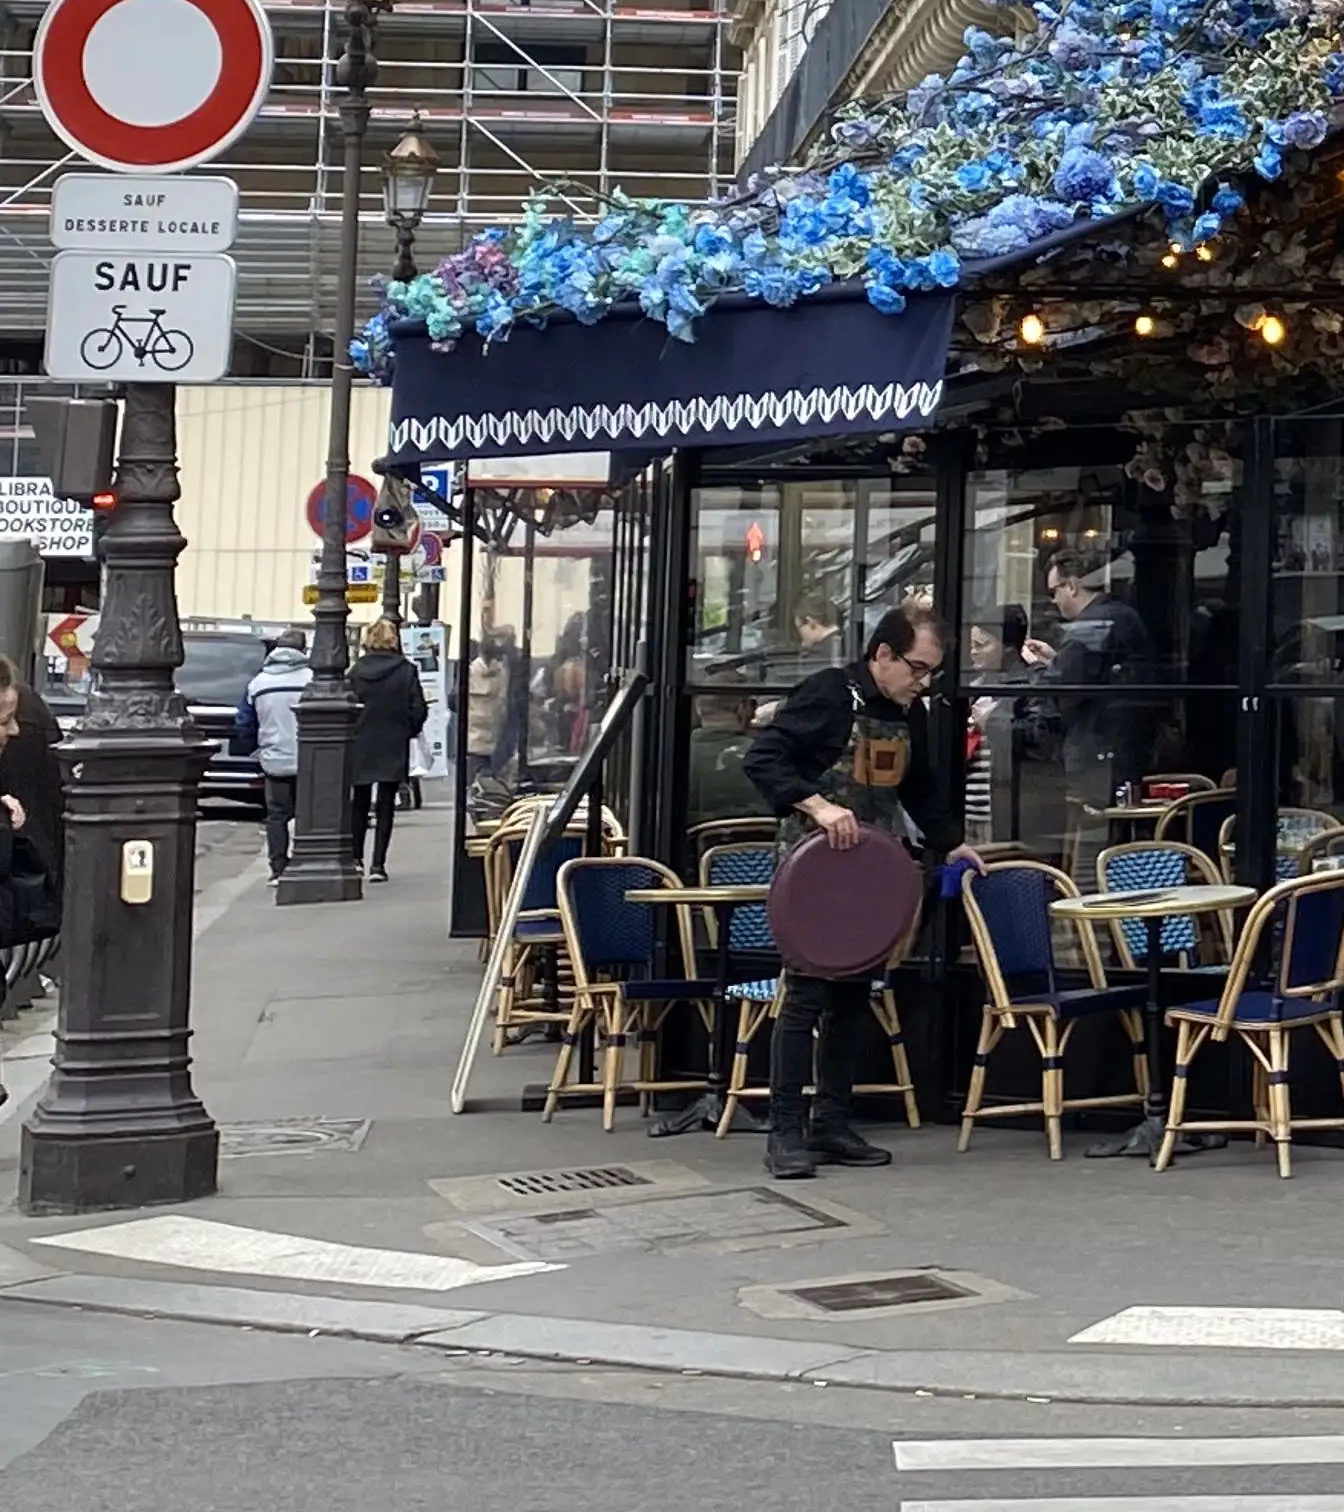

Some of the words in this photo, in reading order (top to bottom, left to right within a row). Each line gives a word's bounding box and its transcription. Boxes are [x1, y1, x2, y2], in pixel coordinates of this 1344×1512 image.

[123, 194, 166, 207] SAUF
[64, 218, 149, 233] DESSERTE
[158, 221, 220, 235] LOCALE
[94, 261, 192, 292] SAUF
[40, 536, 90, 550] SHOP
